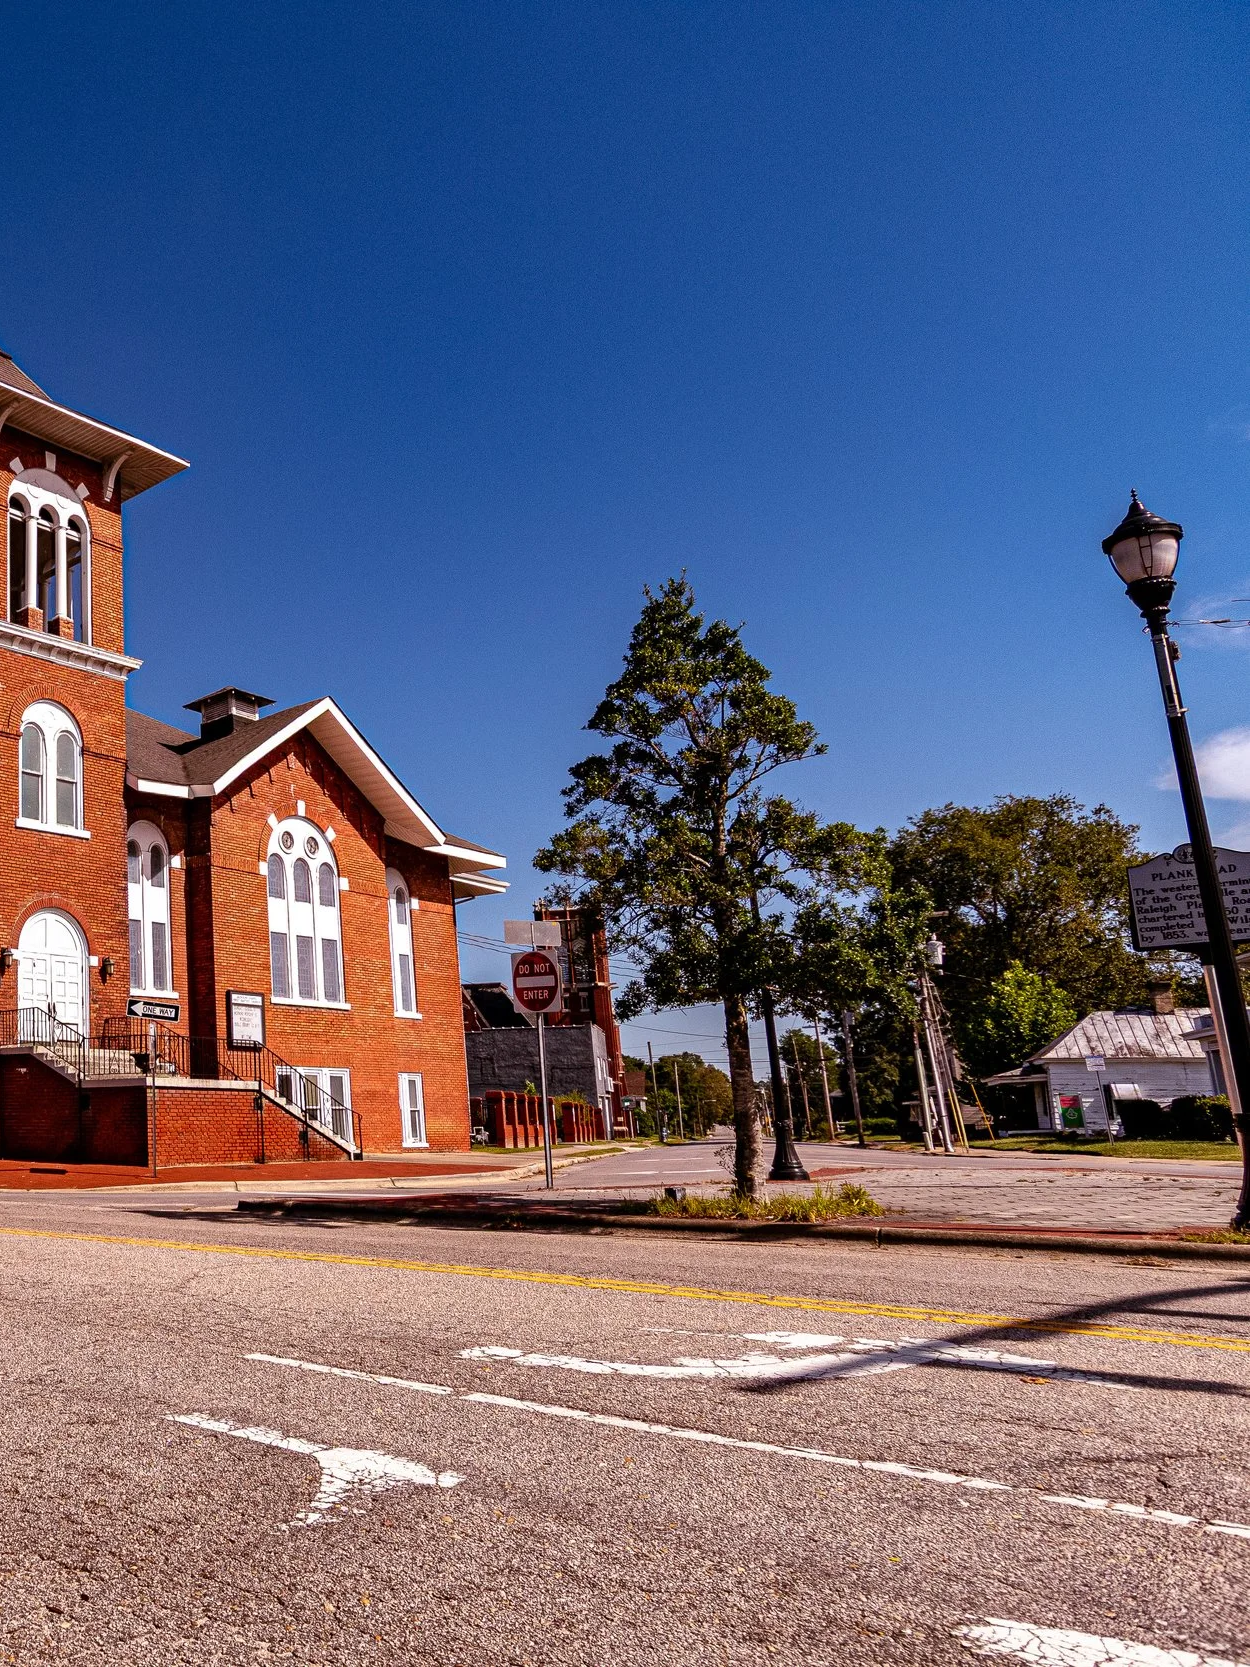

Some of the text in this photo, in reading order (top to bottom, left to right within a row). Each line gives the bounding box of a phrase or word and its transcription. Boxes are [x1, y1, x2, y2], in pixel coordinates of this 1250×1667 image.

[1151, 864, 1237, 881] PLANK AD
[1133, 888, 1155, 896] The
[1160, 884, 1199, 893] wester
[1136, 897, 1147, 905] of
[1152, 895, 1170, 904] the
[1136, 904, 1177, 914] Raleigh
[1186, 901, 1204, 910] Pla
[1138, 911, 1193, 924] chartered
[1139, 921, 1195, 934] completed
[1141, 934, 1156, 943] by
[1230, 927, 1250, 935] ear
[519, 963, 550, 974] DO NOT
[523, 989, 549, 1000] ENTER
[142, 1005, 174, 1018] ONE WAY
